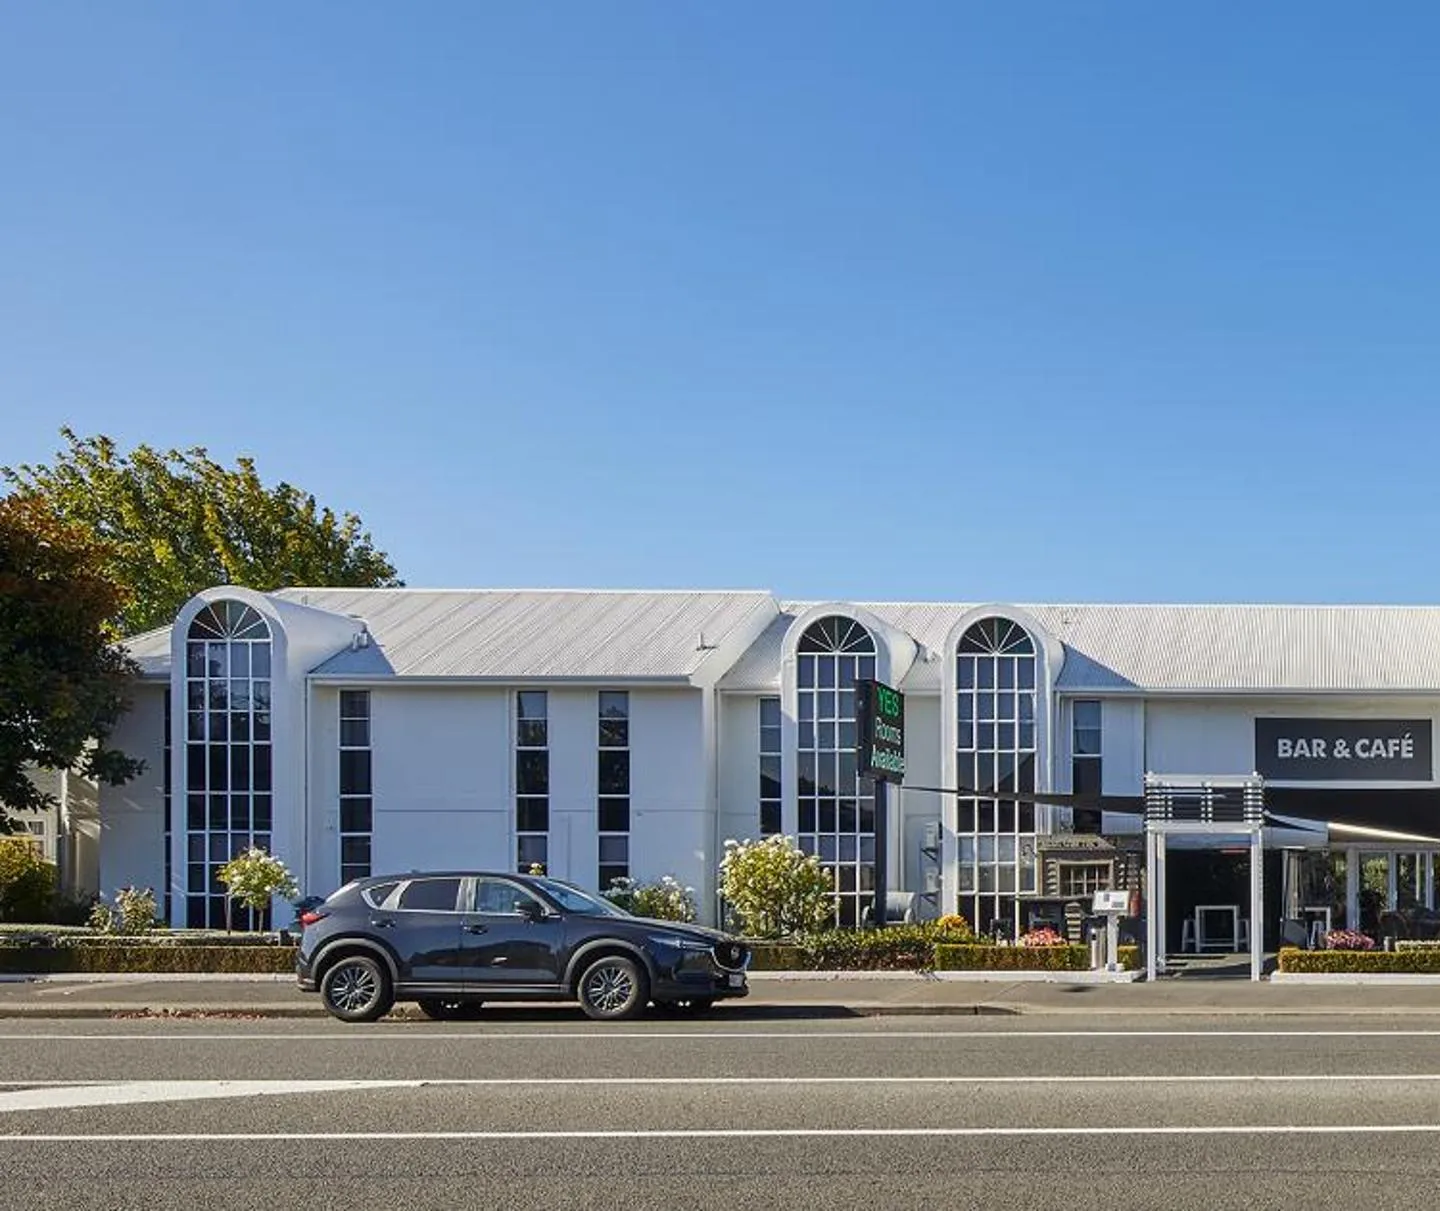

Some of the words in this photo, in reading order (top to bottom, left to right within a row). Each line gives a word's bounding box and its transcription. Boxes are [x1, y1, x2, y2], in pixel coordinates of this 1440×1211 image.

[876, 685, 900, 718] YES
[1277, 738, 1327, 759] BAR
[1332, 738, 1351, 759] &
[1354, 732, 1414, 759] CAFÉ
